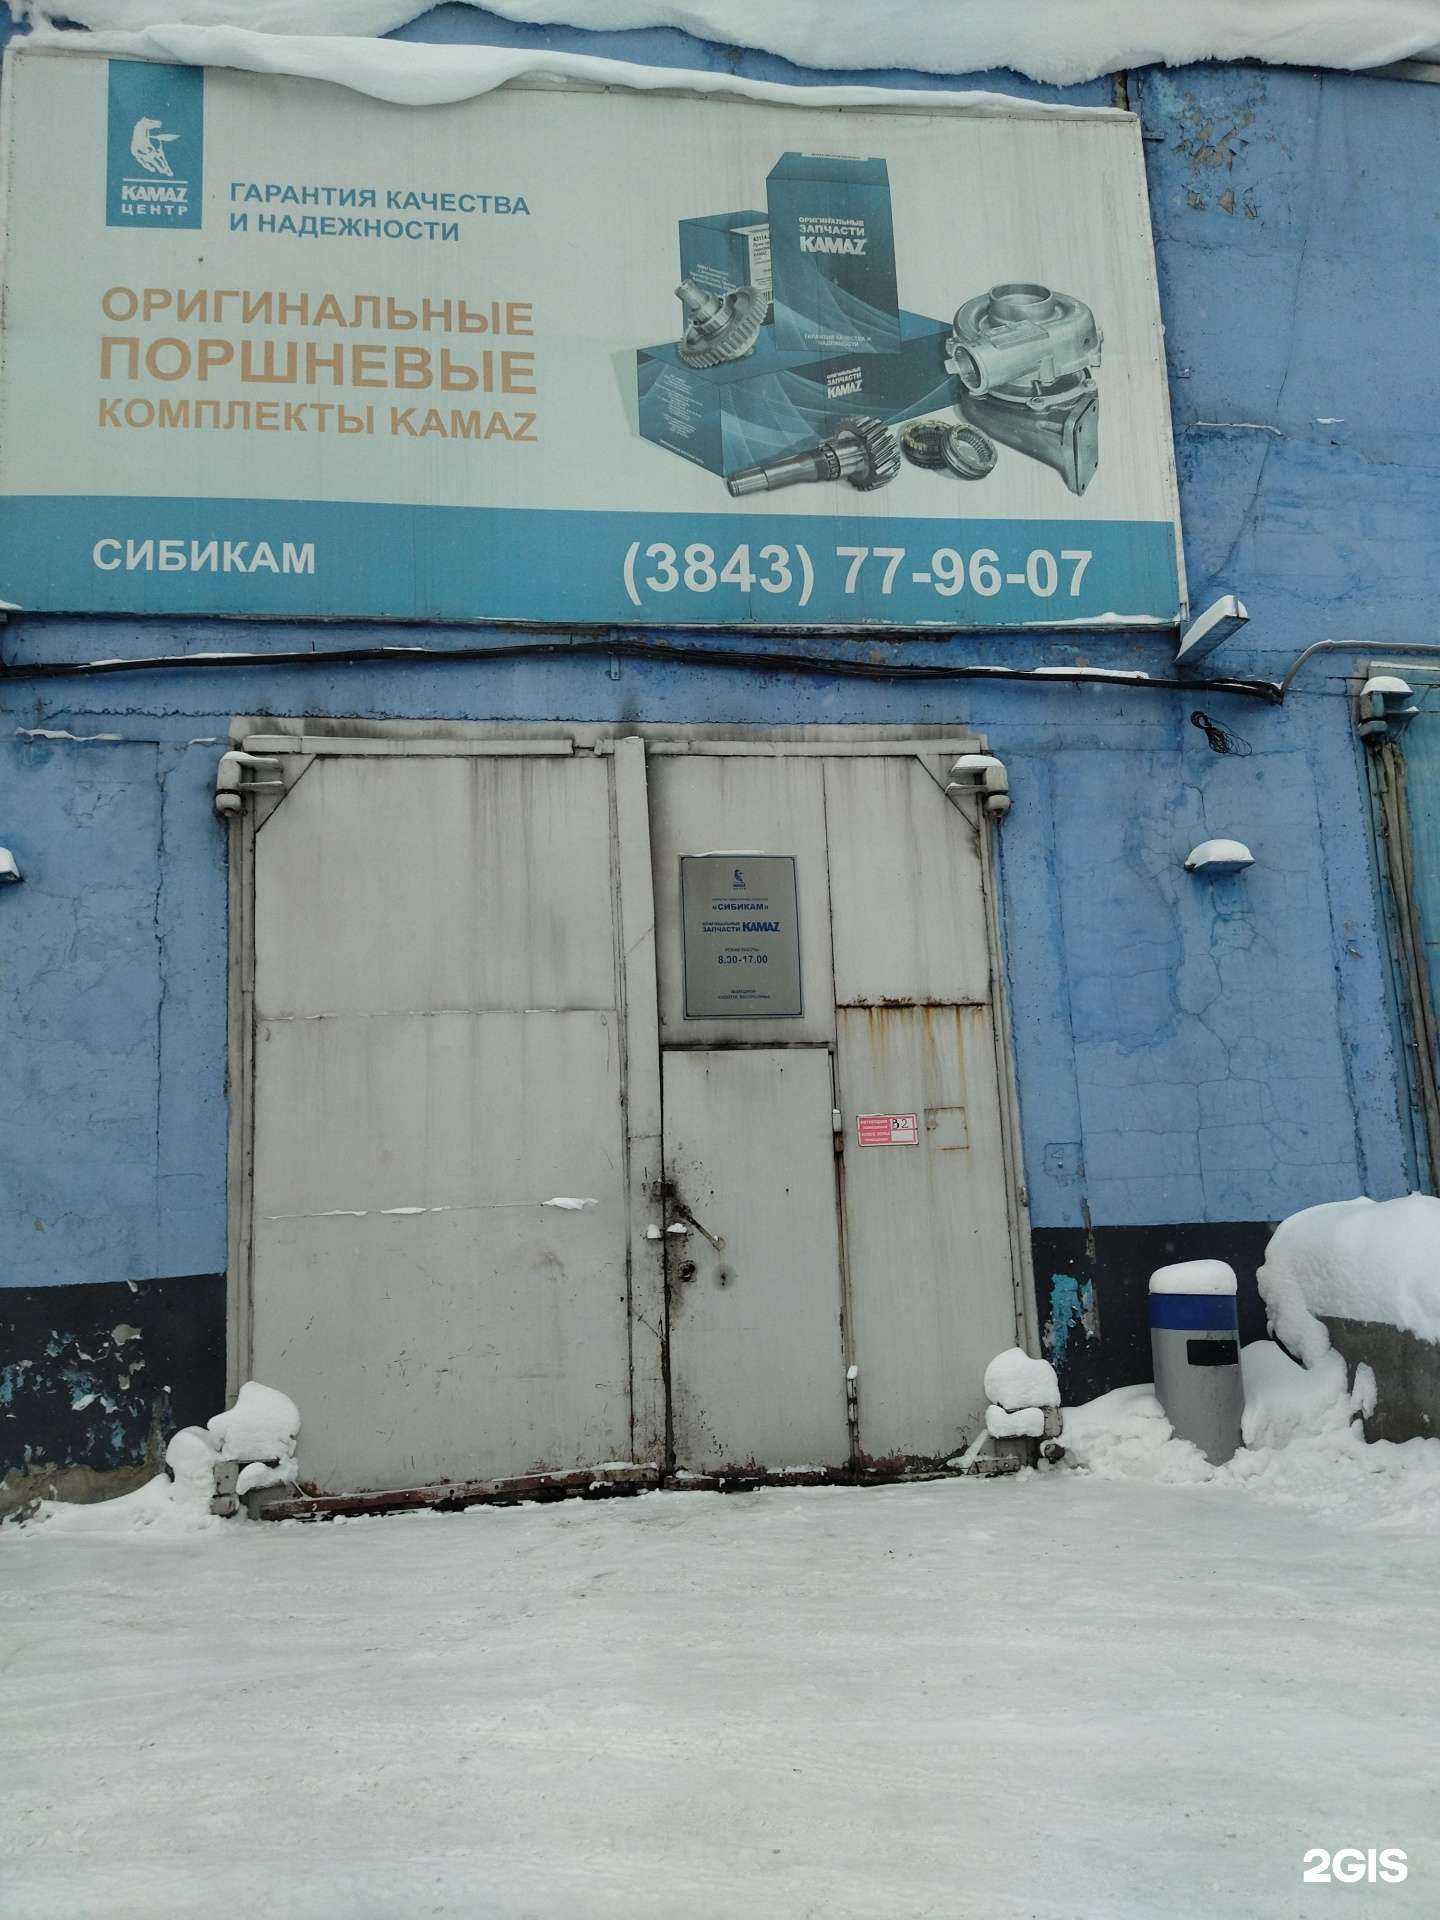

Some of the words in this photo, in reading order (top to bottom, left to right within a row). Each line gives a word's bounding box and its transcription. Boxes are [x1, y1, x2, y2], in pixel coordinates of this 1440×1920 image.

[121, 185, 188, 203] KAMAZ
[230, 182, 377, 210] ГАРАНТИЯ
[386, 189, 531, 216] КАЧЕСТВА
[121, 204, 188, 215] ЦЕНТР
[229, 212, 248, 232] И
[258, 213, 460, 241] НАДЕЖНОСТИ
[798, 225, 865, 236] ЗАПЧАСТИ
[799, 236, 868, 255] KAMAZ
[101, 285, 536, 336] ОРИГИНАЛЬНЫЕ
[99, 336, 537, 395] ПОРШНЕВЫЕ
[826, 380, 863, 399] KAMAZ
[98, 397, 374, 435] КОМПЛЕКТЫ
[390, 406, 538, 442] KAMAZ
[92, 538, 316, 574] СИБИКАМ
[622, 541, 815, 606] (3843)
[836, 546, 1093, 598] 77-96-07
[742, 921, 781, 932] KAMAZ
[718, 954, 768, 964] 8.30-17.00
